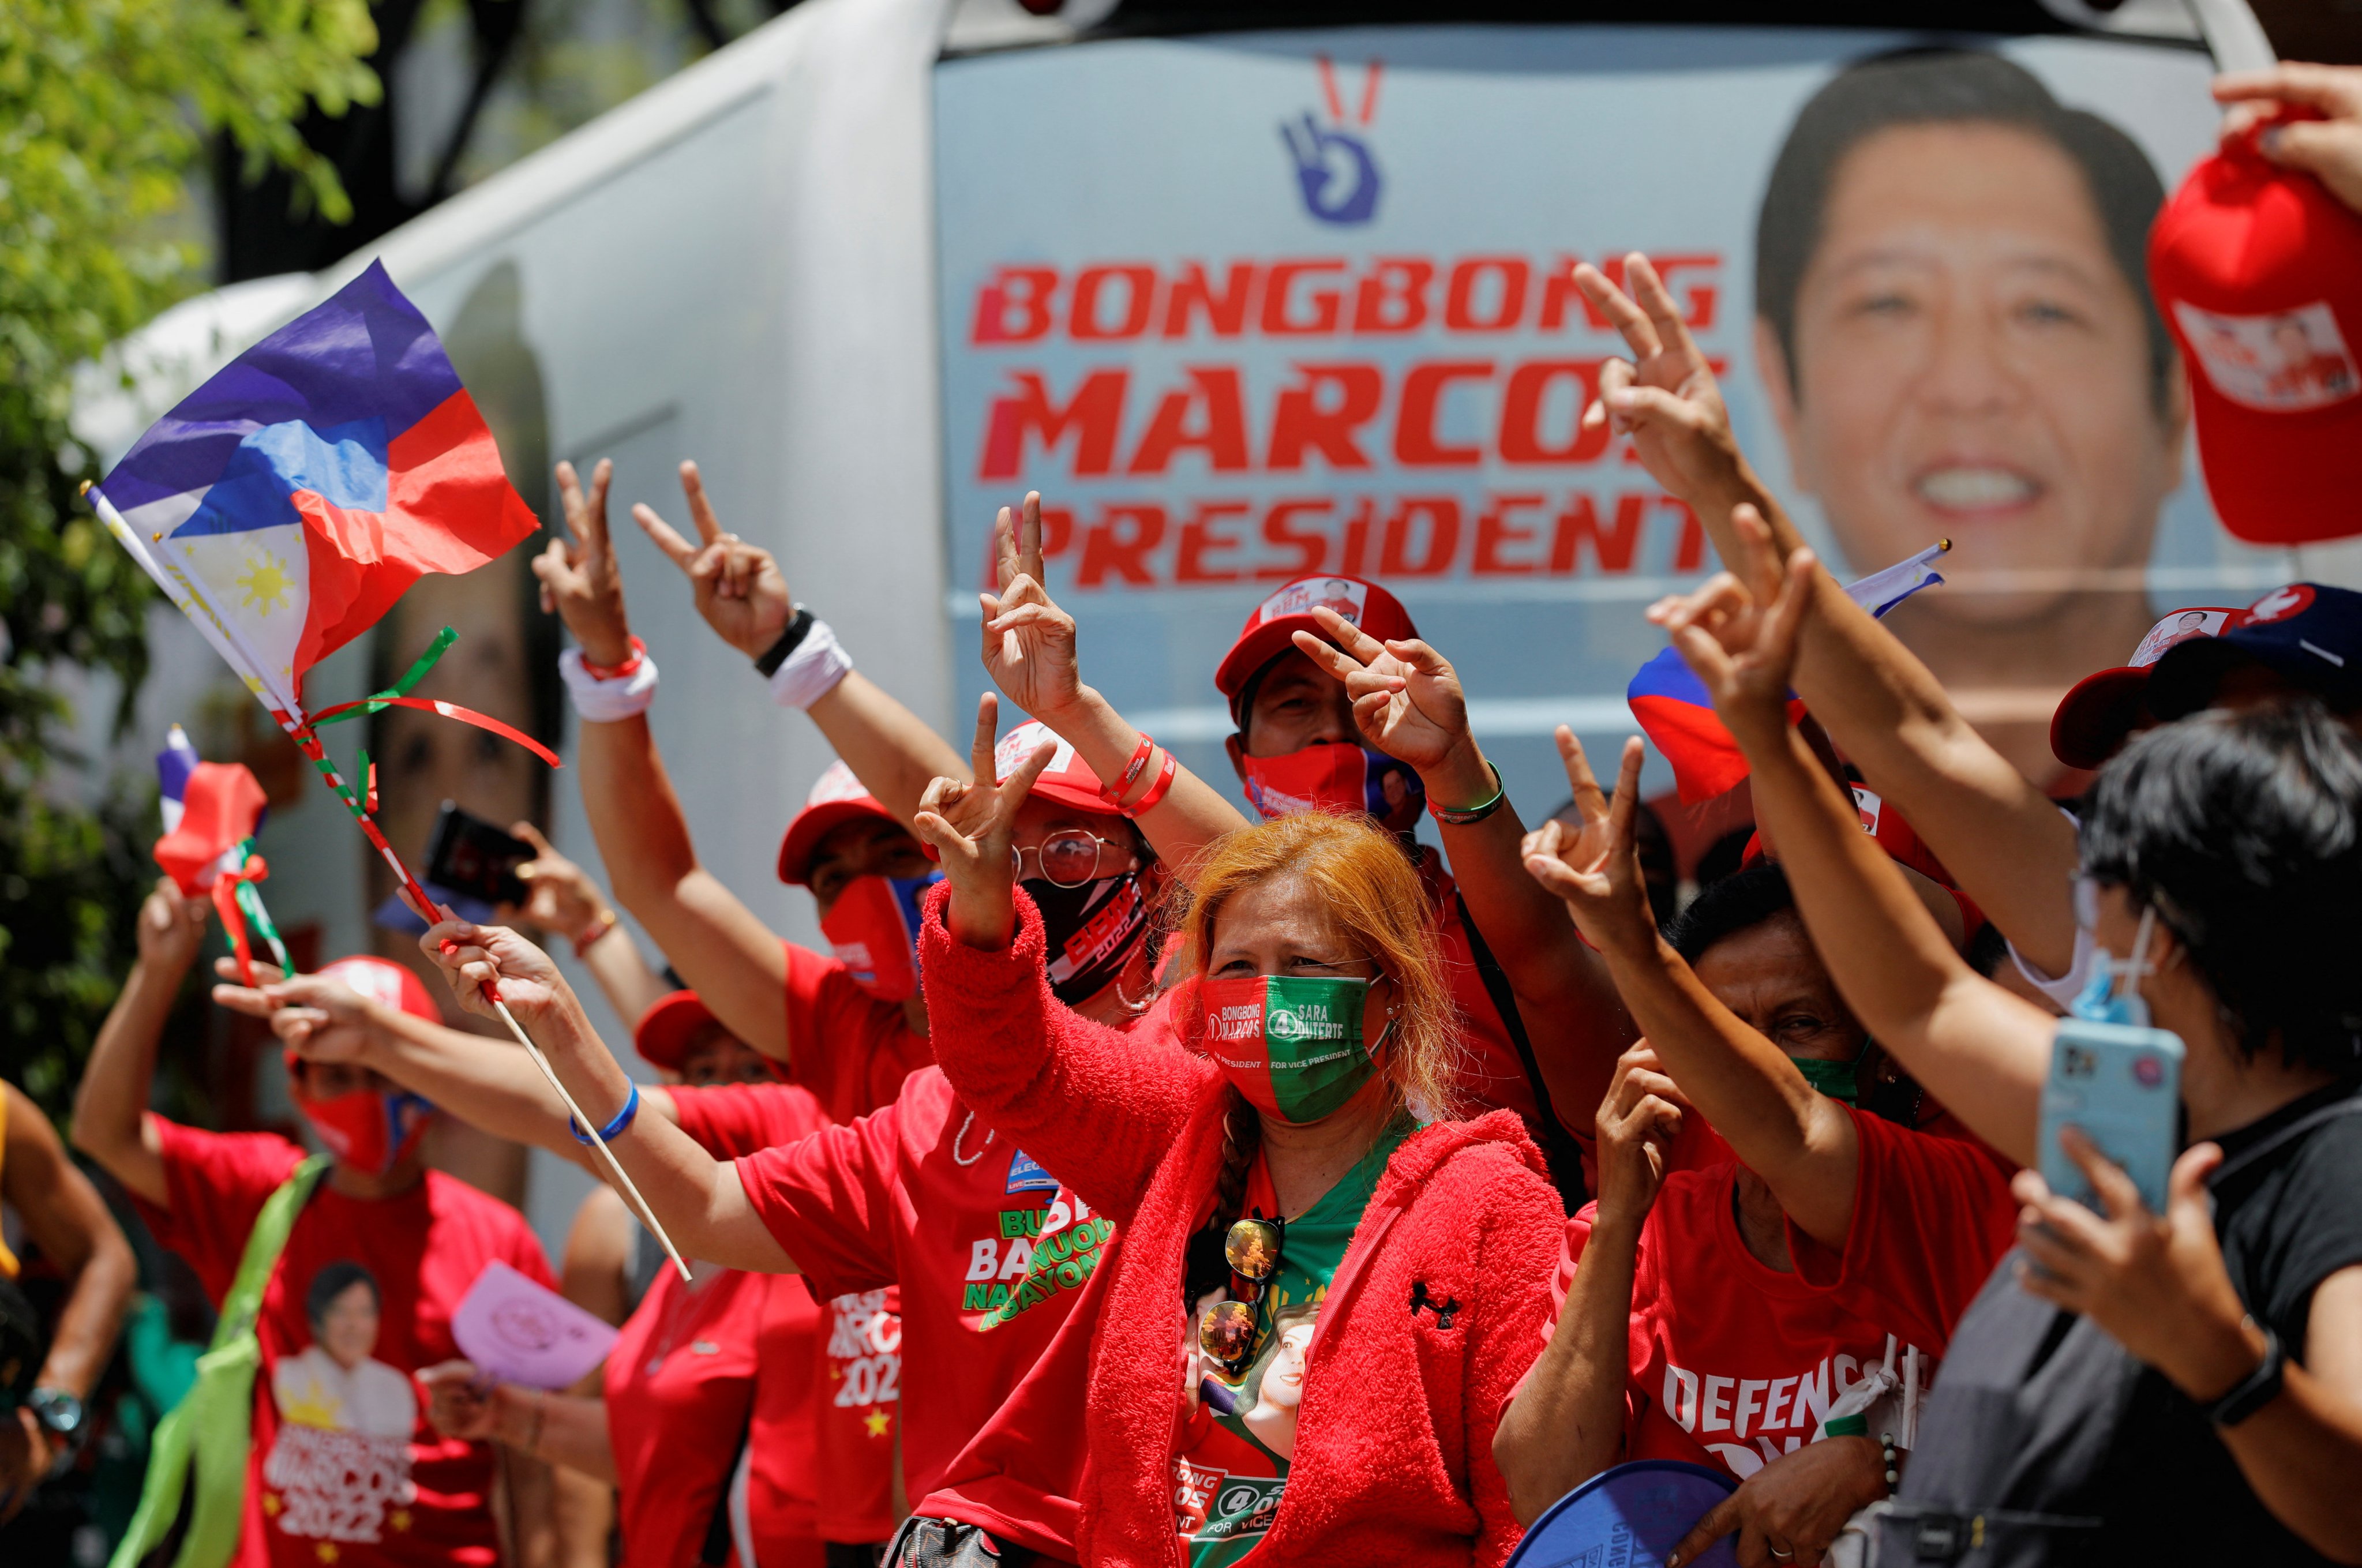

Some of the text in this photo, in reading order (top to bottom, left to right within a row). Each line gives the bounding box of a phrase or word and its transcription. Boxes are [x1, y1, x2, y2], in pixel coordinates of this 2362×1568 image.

[971, 254, 1722, 347] BONGBONG
[980, 359, 1725, 482] MARCO
[1063, 881, 1135, 966] BBM
[1222, 1003, 1260, 1021] BONGBONG
[1299, 1004, 1328, 1022] SARA
[1222, 1019, 1260, 1041] MARCOS
[1275, 1014, 1290, 1036] 4
[1298, 1022, 1343, 1040] DUTERTE
[1221, 1056, 1261, 1068] PRESIDENT
[1289, 1060, 1308, 1068] VICE
[1309, 1049, 1351, 1065] PRESIDENT
[1009, 1181, 1023, 1189] LIVE
[833, 1353, 902, 1408] 202
[1171, 1466, 1218, 1489] ONG
[1227, 1491, 1252, 1513] 4
[278, 1497, 383, 1544] 2022
[1207, 1514, 1273, 1533] FOR VICE
